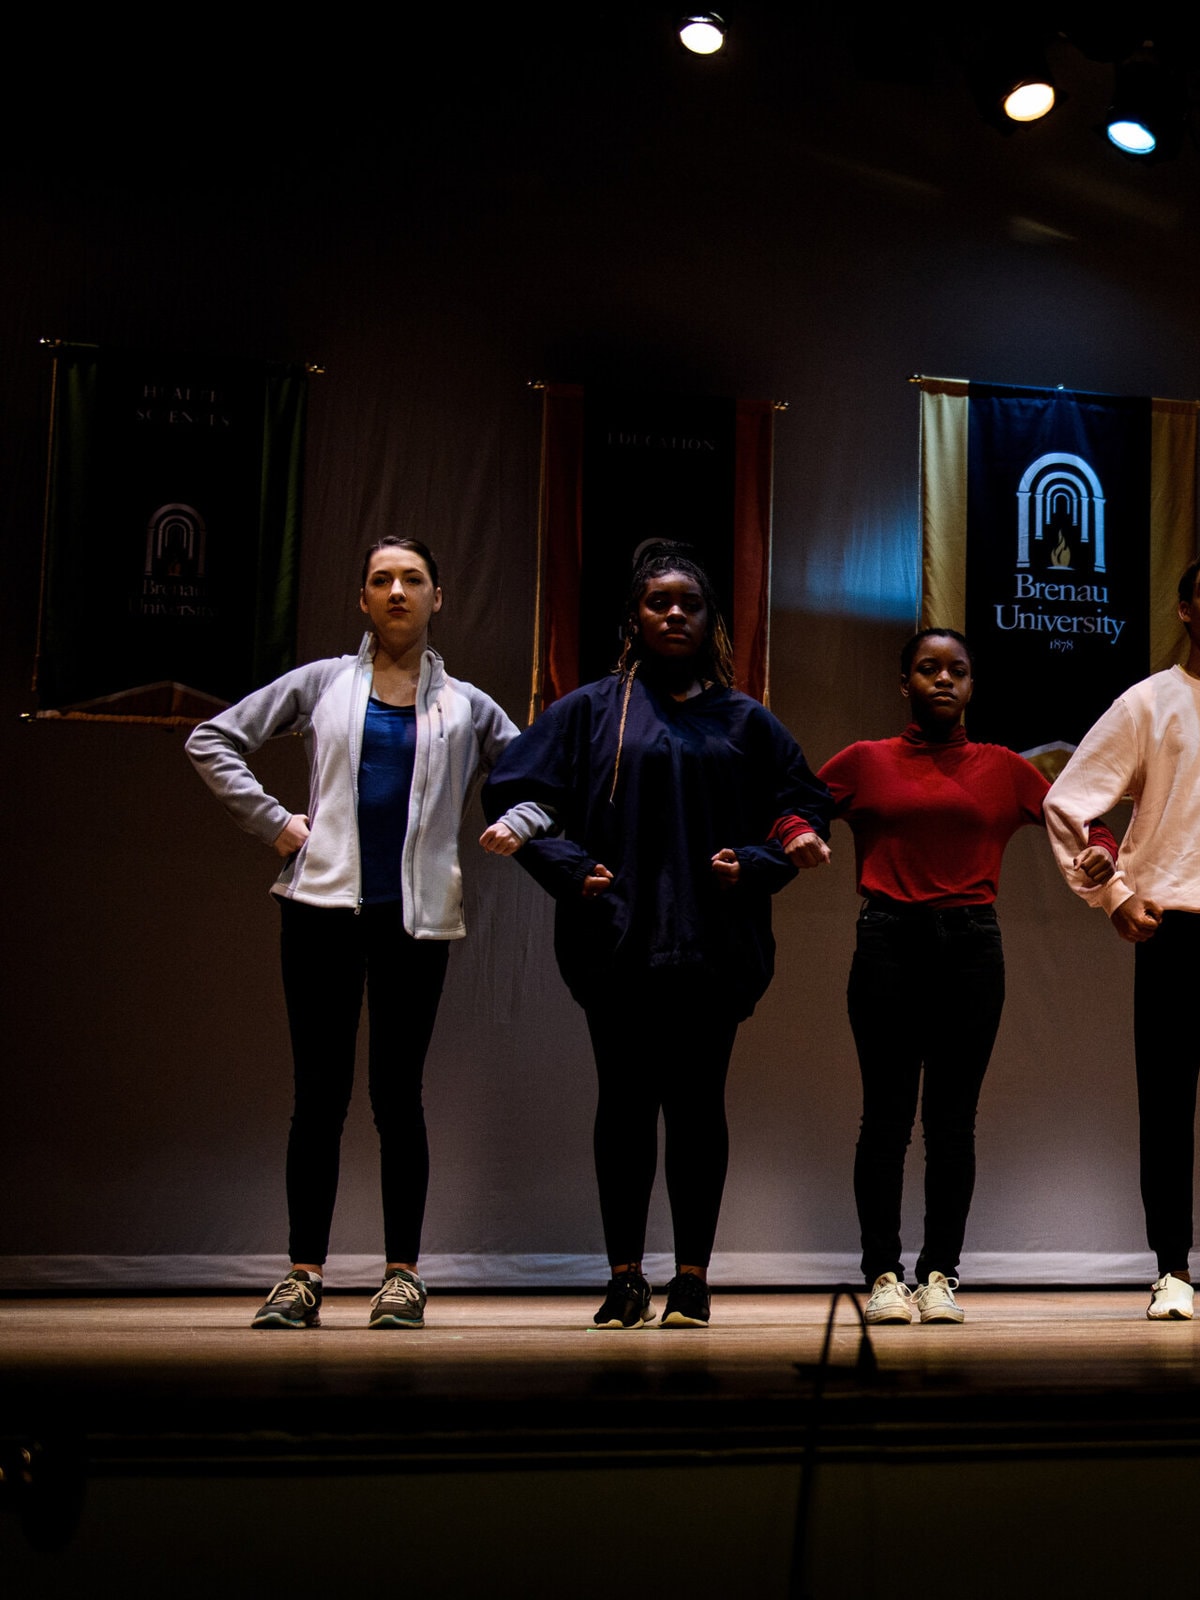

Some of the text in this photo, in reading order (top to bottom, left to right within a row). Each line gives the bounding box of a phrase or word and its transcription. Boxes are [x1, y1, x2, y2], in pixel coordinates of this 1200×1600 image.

[1014, 573, 1109, 603] Brenau
[994, 604, 1126, 644] University
[1050, 639, 1074, 652] 1878
